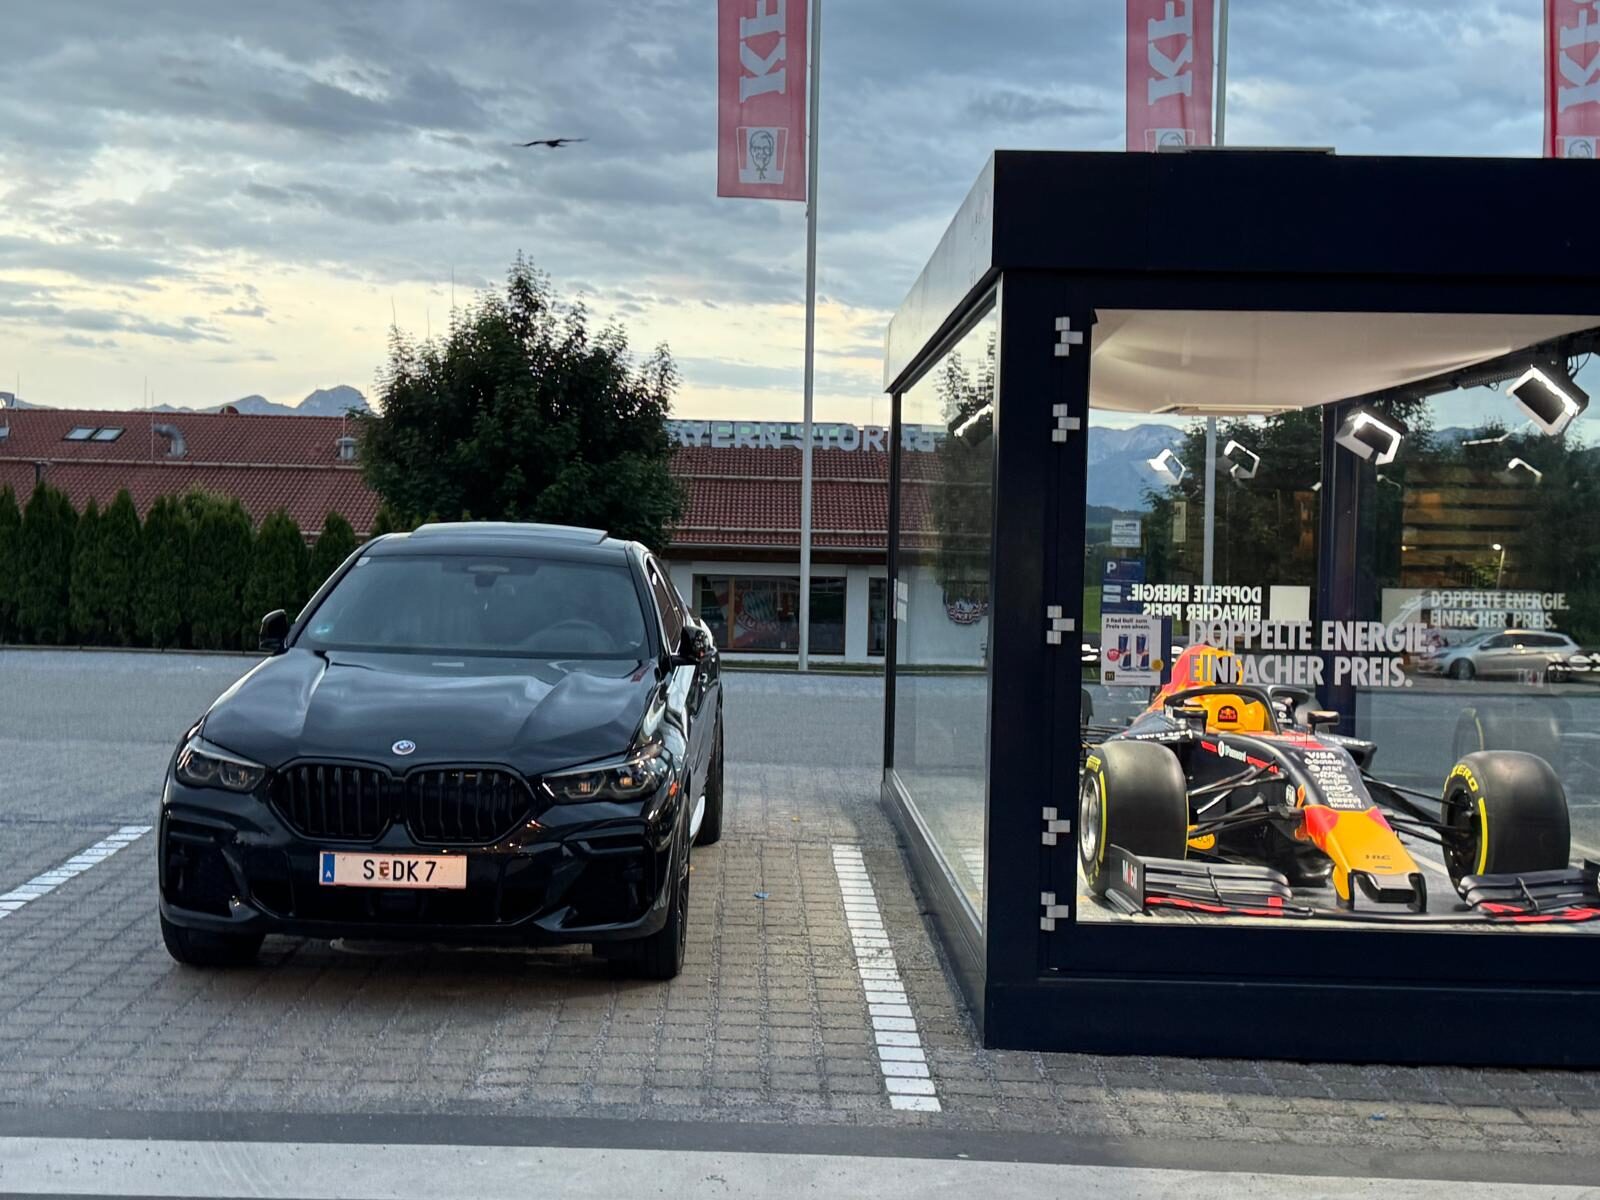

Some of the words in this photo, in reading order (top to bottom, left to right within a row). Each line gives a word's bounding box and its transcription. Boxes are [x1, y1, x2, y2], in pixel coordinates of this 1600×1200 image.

[794, 422, 891, 452] STOR
[1107, 561, 1117, 574] P
[1430, 591, 1502, 609] DOPPELTE
[1504, 592, 1570, 610] ENERGIE.
[1430, 610, 1507, 628] EINFACHER
[1512, 611, 1558, 629] PREIS.
[1189, 620, 1313, 650] DOPPELTE
[1321, 620, 1436, 652] ENERGIE.
[1189, 655, 1324, 685] EINFACHER
[1334, 656, 1413, 687] PREIS.
[363, 858, 376, 880] S
[392, 860, 419, 882] DK
[425, 860, 437, 882] 7
